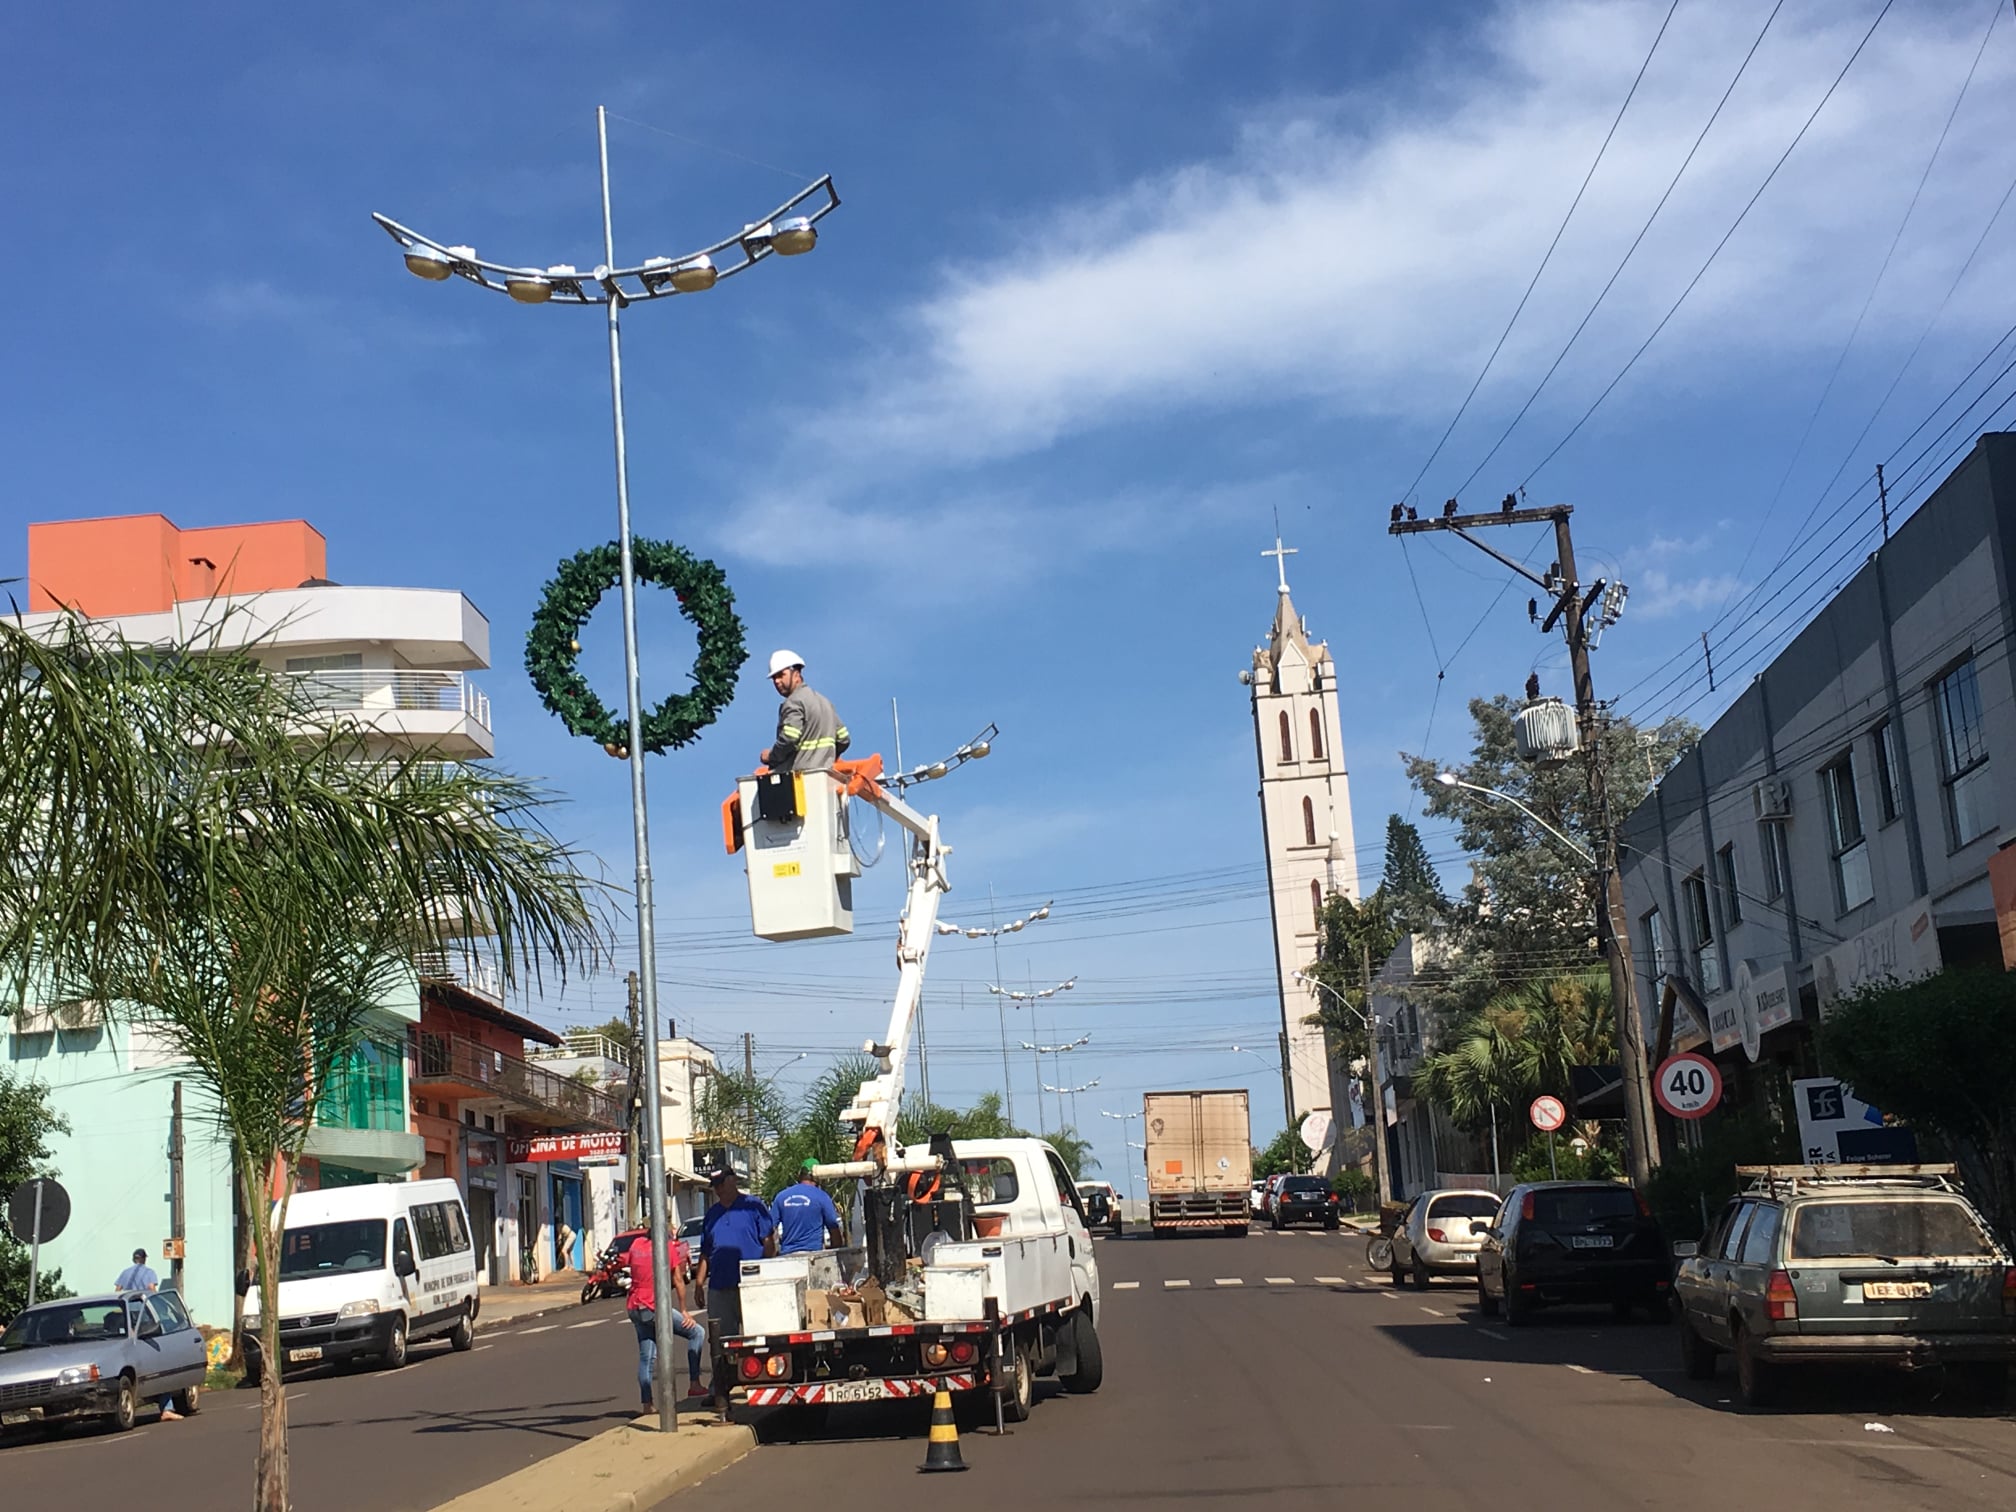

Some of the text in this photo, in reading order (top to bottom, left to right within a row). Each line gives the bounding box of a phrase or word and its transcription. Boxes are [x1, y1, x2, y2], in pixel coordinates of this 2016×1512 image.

[1670, 1068, 1705, 1096] 40
[561, 1134, 576, 1151] DE
[580, 1131, 621, 1149] MOTOS
